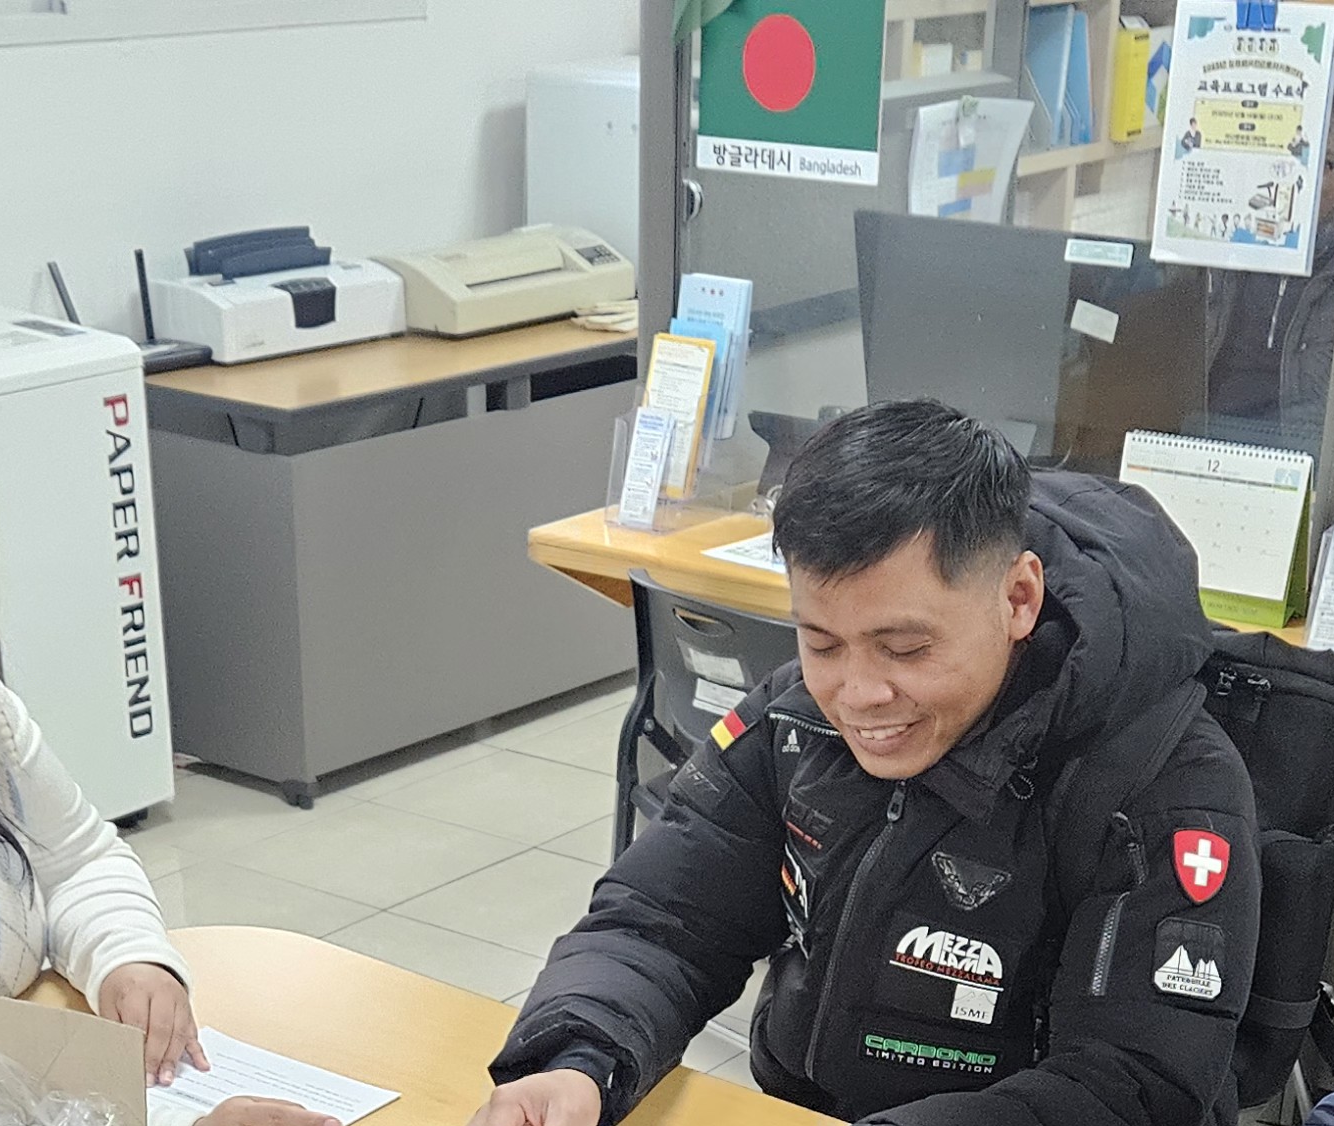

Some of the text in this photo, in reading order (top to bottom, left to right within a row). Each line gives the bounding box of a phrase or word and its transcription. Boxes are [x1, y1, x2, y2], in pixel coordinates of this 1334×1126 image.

[712, 143, 862, 177] 방글라데시 Bangladesh
[1207, 459, 1221, 473] 12
[103, 393, 154, 739] PAPER FRIEND
[894, 952, 1003, 987] TROFEO MEZZALAMA
[954, 1006, 990, 1020] ISMF
[865, 1034, 997, 1066] CARBONIO
[866, 1048, 994, 1074] LIMITED EDITION
